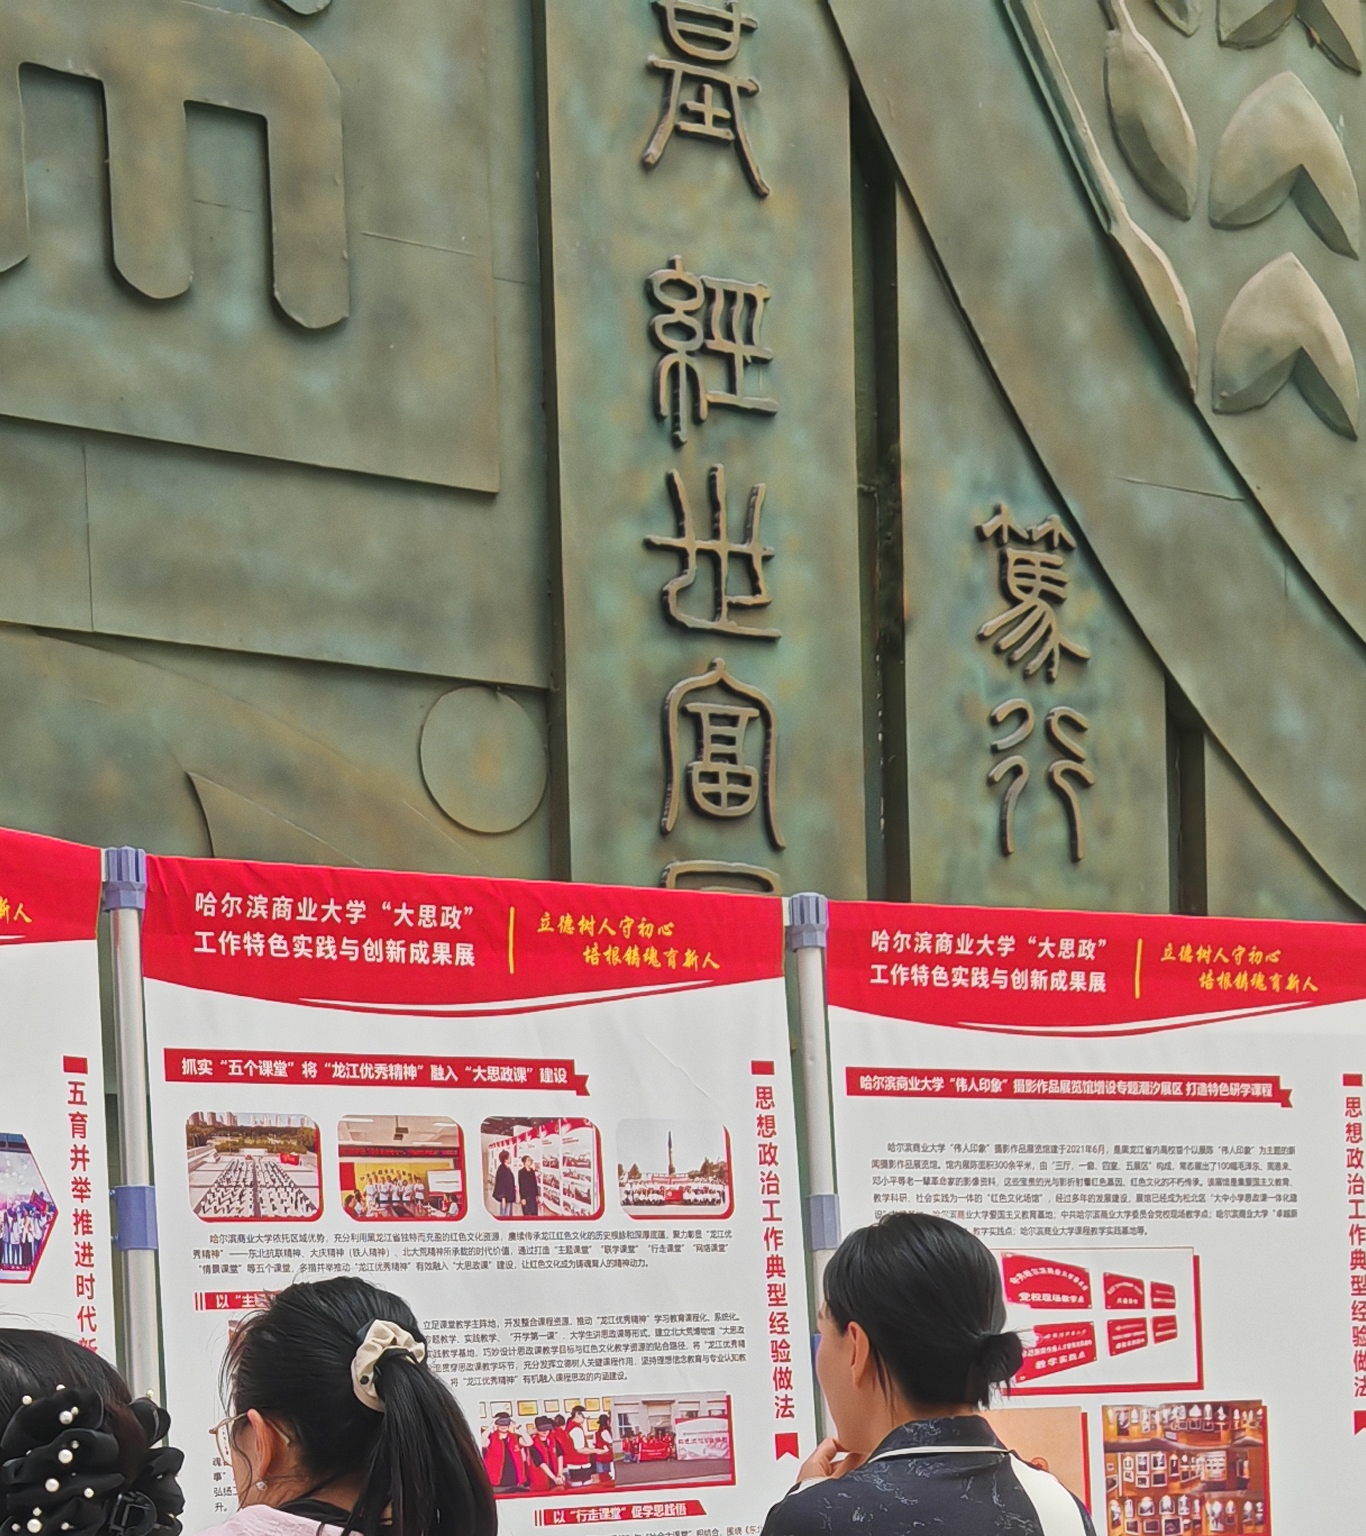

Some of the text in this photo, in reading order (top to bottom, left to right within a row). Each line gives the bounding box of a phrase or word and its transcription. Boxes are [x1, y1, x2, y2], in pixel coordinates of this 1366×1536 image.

[195, 890, 474, 930] 哈尔滨商业大学“大思政”
[537, 911, 676, 939] 立德树人守初心
[194, 929, 475, 968] 工作特色实践与创新成果展
[583, 943, 721, 972] 培根铸魂育新人
[871, 929, 1108, 962] 哈尔滨商业大学“大思政”
[1160, 943, 1282, 964] 立德树人守初心
[869, 962, 1107, 994] 工作特色实践与创新成果展
[1199, 971, 1320, 995] 培根铸魂育新人
[754, 1085, 796, 1420] 思想政治工作典型经验做法
